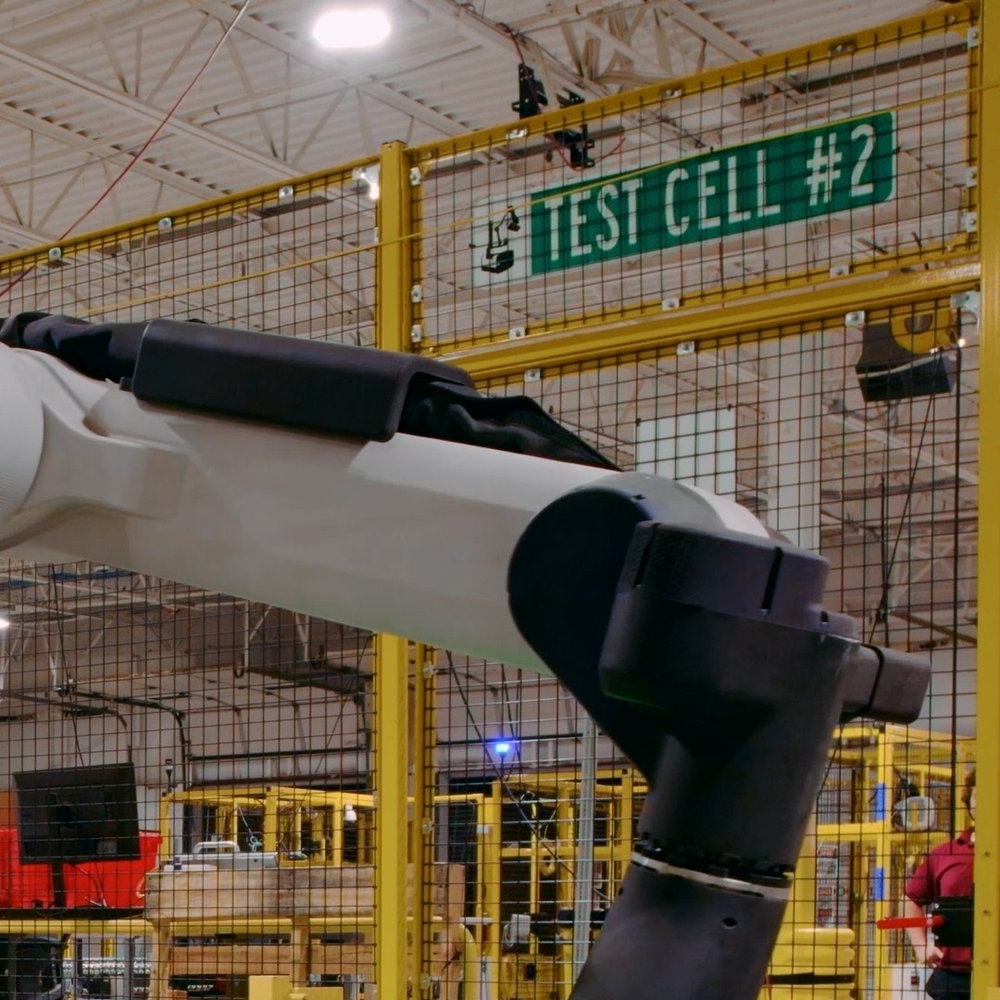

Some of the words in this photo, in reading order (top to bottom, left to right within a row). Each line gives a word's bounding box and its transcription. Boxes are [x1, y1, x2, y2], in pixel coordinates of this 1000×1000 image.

[544, 177, 644, 262] TEST
[665, 148, 781, 237] CELL
[805, 124, 877, 206] #2
